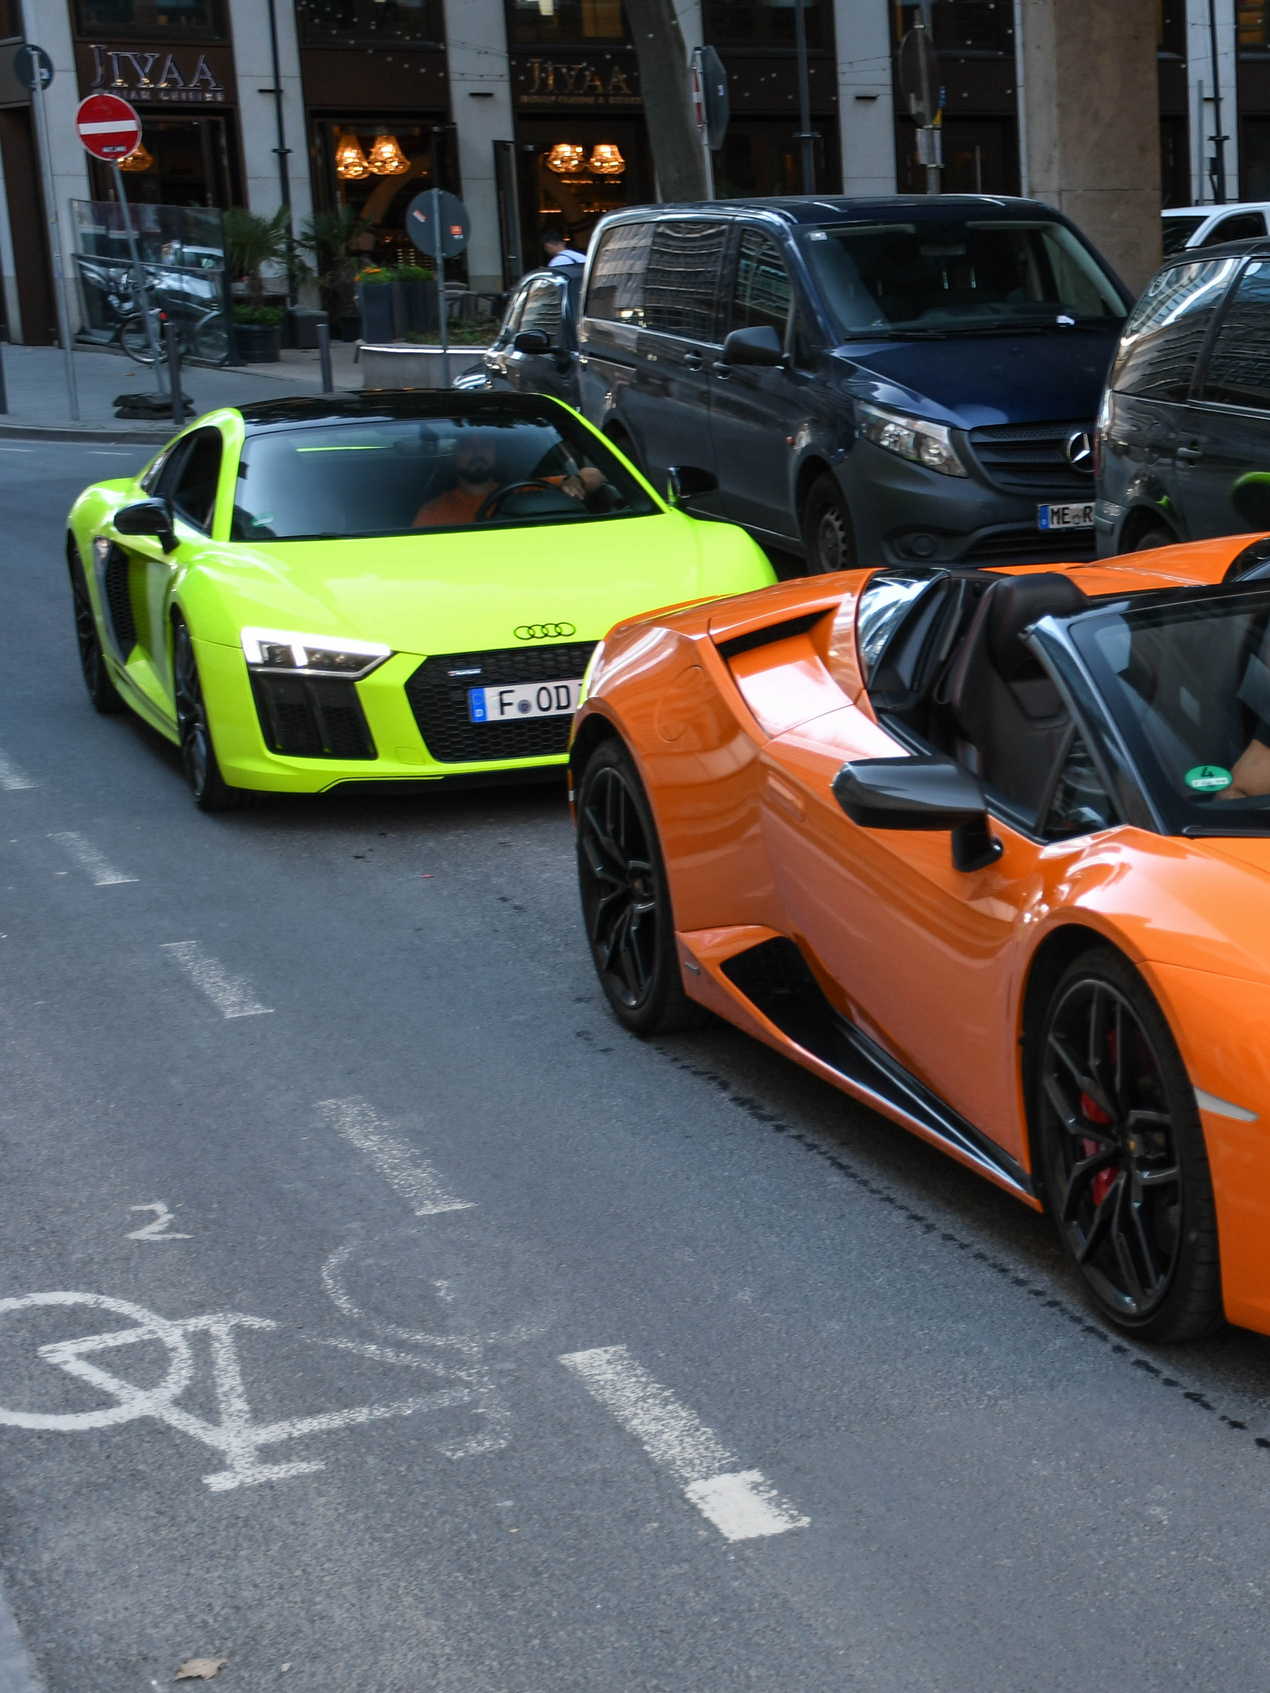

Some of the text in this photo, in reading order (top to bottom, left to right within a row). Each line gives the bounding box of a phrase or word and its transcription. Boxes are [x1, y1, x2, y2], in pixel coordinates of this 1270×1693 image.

[88, 44, 225, 91] JIYAA
[529, 58, 632, 94] JIYAA
[1050, 505, 1093, 525] ME R
[498, 689, 515, 716] F
[536, 684, 570, 712] OD
[1201, 766, 1215, 778] 4
